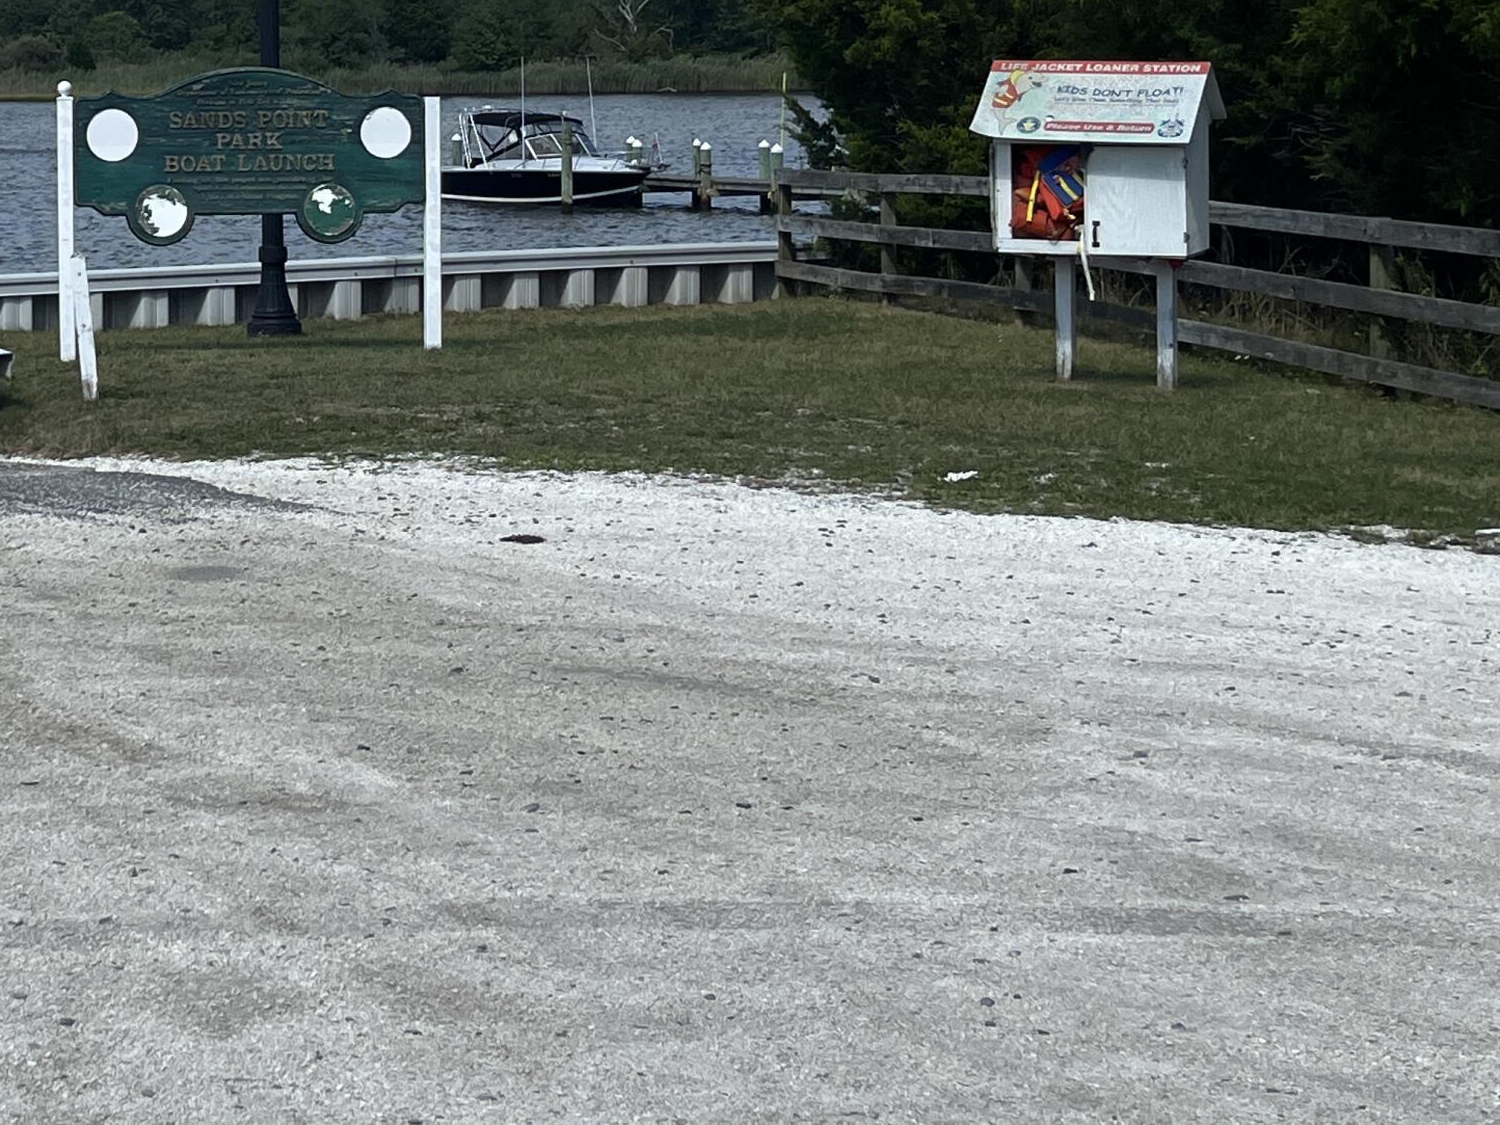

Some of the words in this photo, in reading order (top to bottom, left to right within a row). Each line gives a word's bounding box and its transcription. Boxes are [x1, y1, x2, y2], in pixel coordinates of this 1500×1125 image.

[1000, 62, 1029, 71] LIFE
[1031, 63, 1084, 72] JACKET
[1085, 63, 1141, 73] LOANER
[1142, 63, 1202, 73] STATION
[1056, 85, 1089, 96] KIDS
[170, 111, 246, 128] SANDS
[258, 111, 329, 128] POINT
[216, 133, 283, 149] PARK
[164, 155, 226, 172] BOAT
[237, 153, 335, 171] LAUNCH
